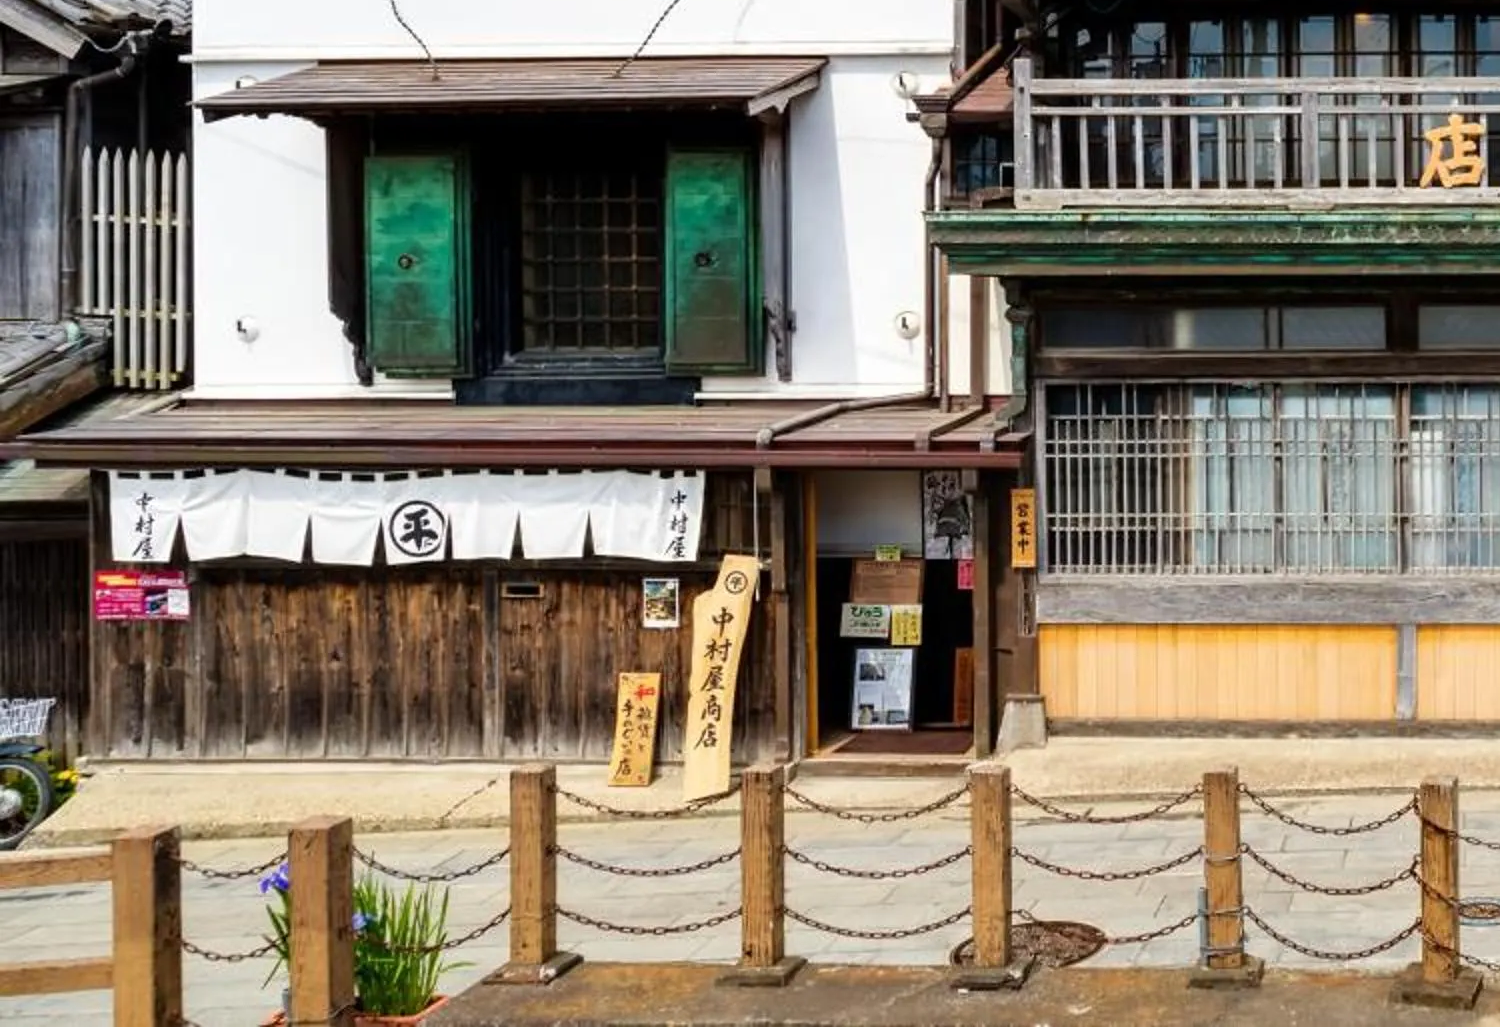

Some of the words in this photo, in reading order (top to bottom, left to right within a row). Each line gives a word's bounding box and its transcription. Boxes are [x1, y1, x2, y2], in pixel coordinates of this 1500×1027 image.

[132, 491, 155, 560] 中村屋
[665, 490, 688, 558] 中村屋
[1016, 503, 1030, 556] 営業中
[694, 606, 735, 750] 中村屋商店
